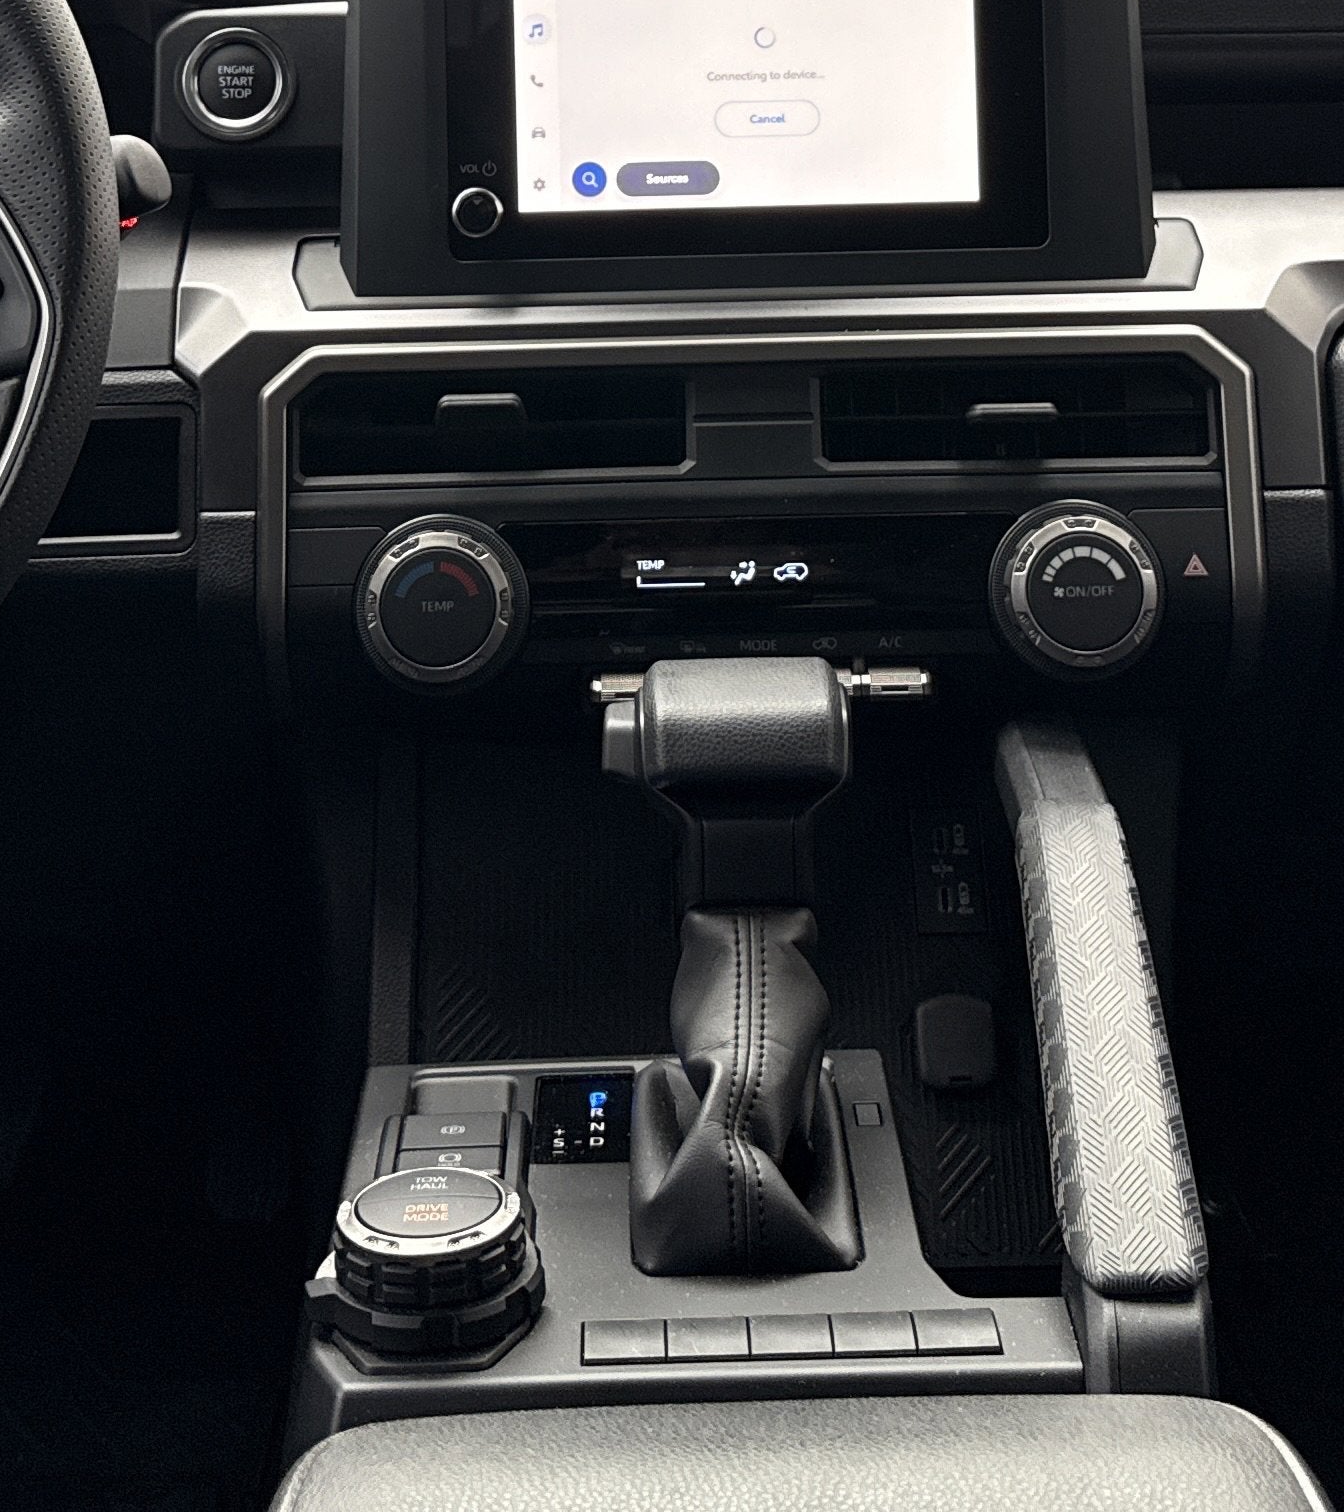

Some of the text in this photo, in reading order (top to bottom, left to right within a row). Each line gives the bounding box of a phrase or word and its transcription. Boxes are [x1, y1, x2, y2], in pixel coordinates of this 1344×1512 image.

[217, 65, 255, 75] ENGINE
[218, 76, 254, 87] START
[706, 70, 767, 84] Connecting
[769, 70, 781, 82] to
[221, 88, 252, 99] STOP
[749, 113, 786, 125] Cancel
[459, 164, 479, 175] VOL
[645, 172, 689, 185] Sources
[636, 560, 666, 570] TEMP
[1066, 585, 1114, 598] ON/OFF
[421, 600, 455, 612] TEMP
[739, 639, 778, 651] MODE
[879, 636, 903, 649] A/C
[589, 1091, 608, 1108] P
[590, 1108, 605, 1118] R
[590, 1122, 605, 1133] N
[552, 1137, 565, 1148] S
[590, 1137, 604, 1148] D
[410, 1182, 448, 1190] HAUL
[405, 1203, 449, 1213] DRIVE
[403, 1213, 449, 1222] MODE
